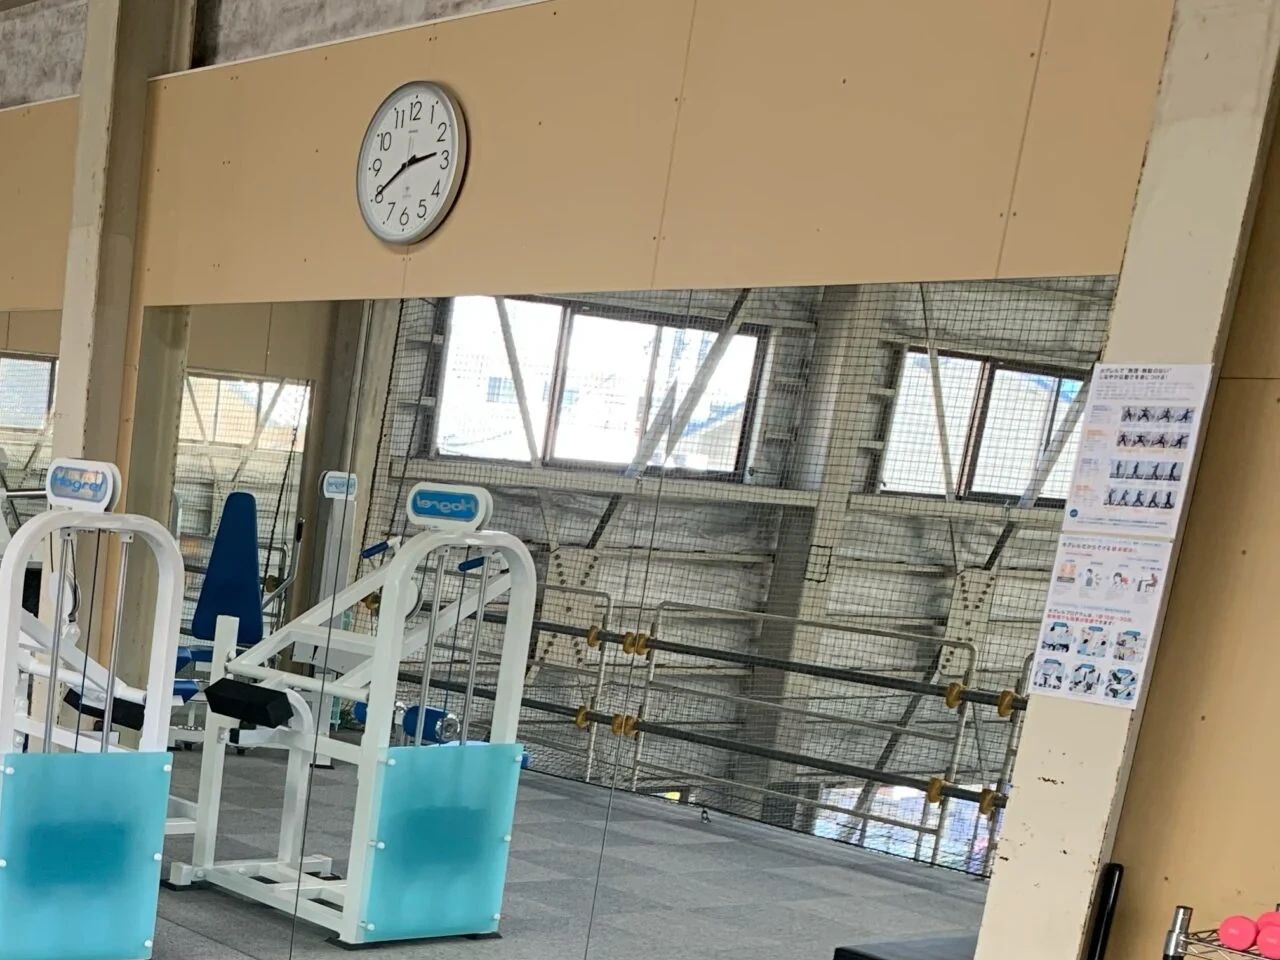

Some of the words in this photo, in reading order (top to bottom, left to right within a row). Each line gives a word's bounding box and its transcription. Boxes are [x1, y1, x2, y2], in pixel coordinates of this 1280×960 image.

[394, 109, 405, 130] 11
[409, 100, 423, 121] 12
[430, 105, 435, 125] 1
[379, 131, 392, 151] 10
[437, 122, 448, 142] 2
[372, 158, 382, 177] 9
[440, 150, 449, 169] 3
[374, 184, 384, 204] 8
[431, 179, 441, 198] 4
[386, 202, 396, 221] 7
[399, 206, 410, 226] 6
[416, 199, 428, 219] 5
